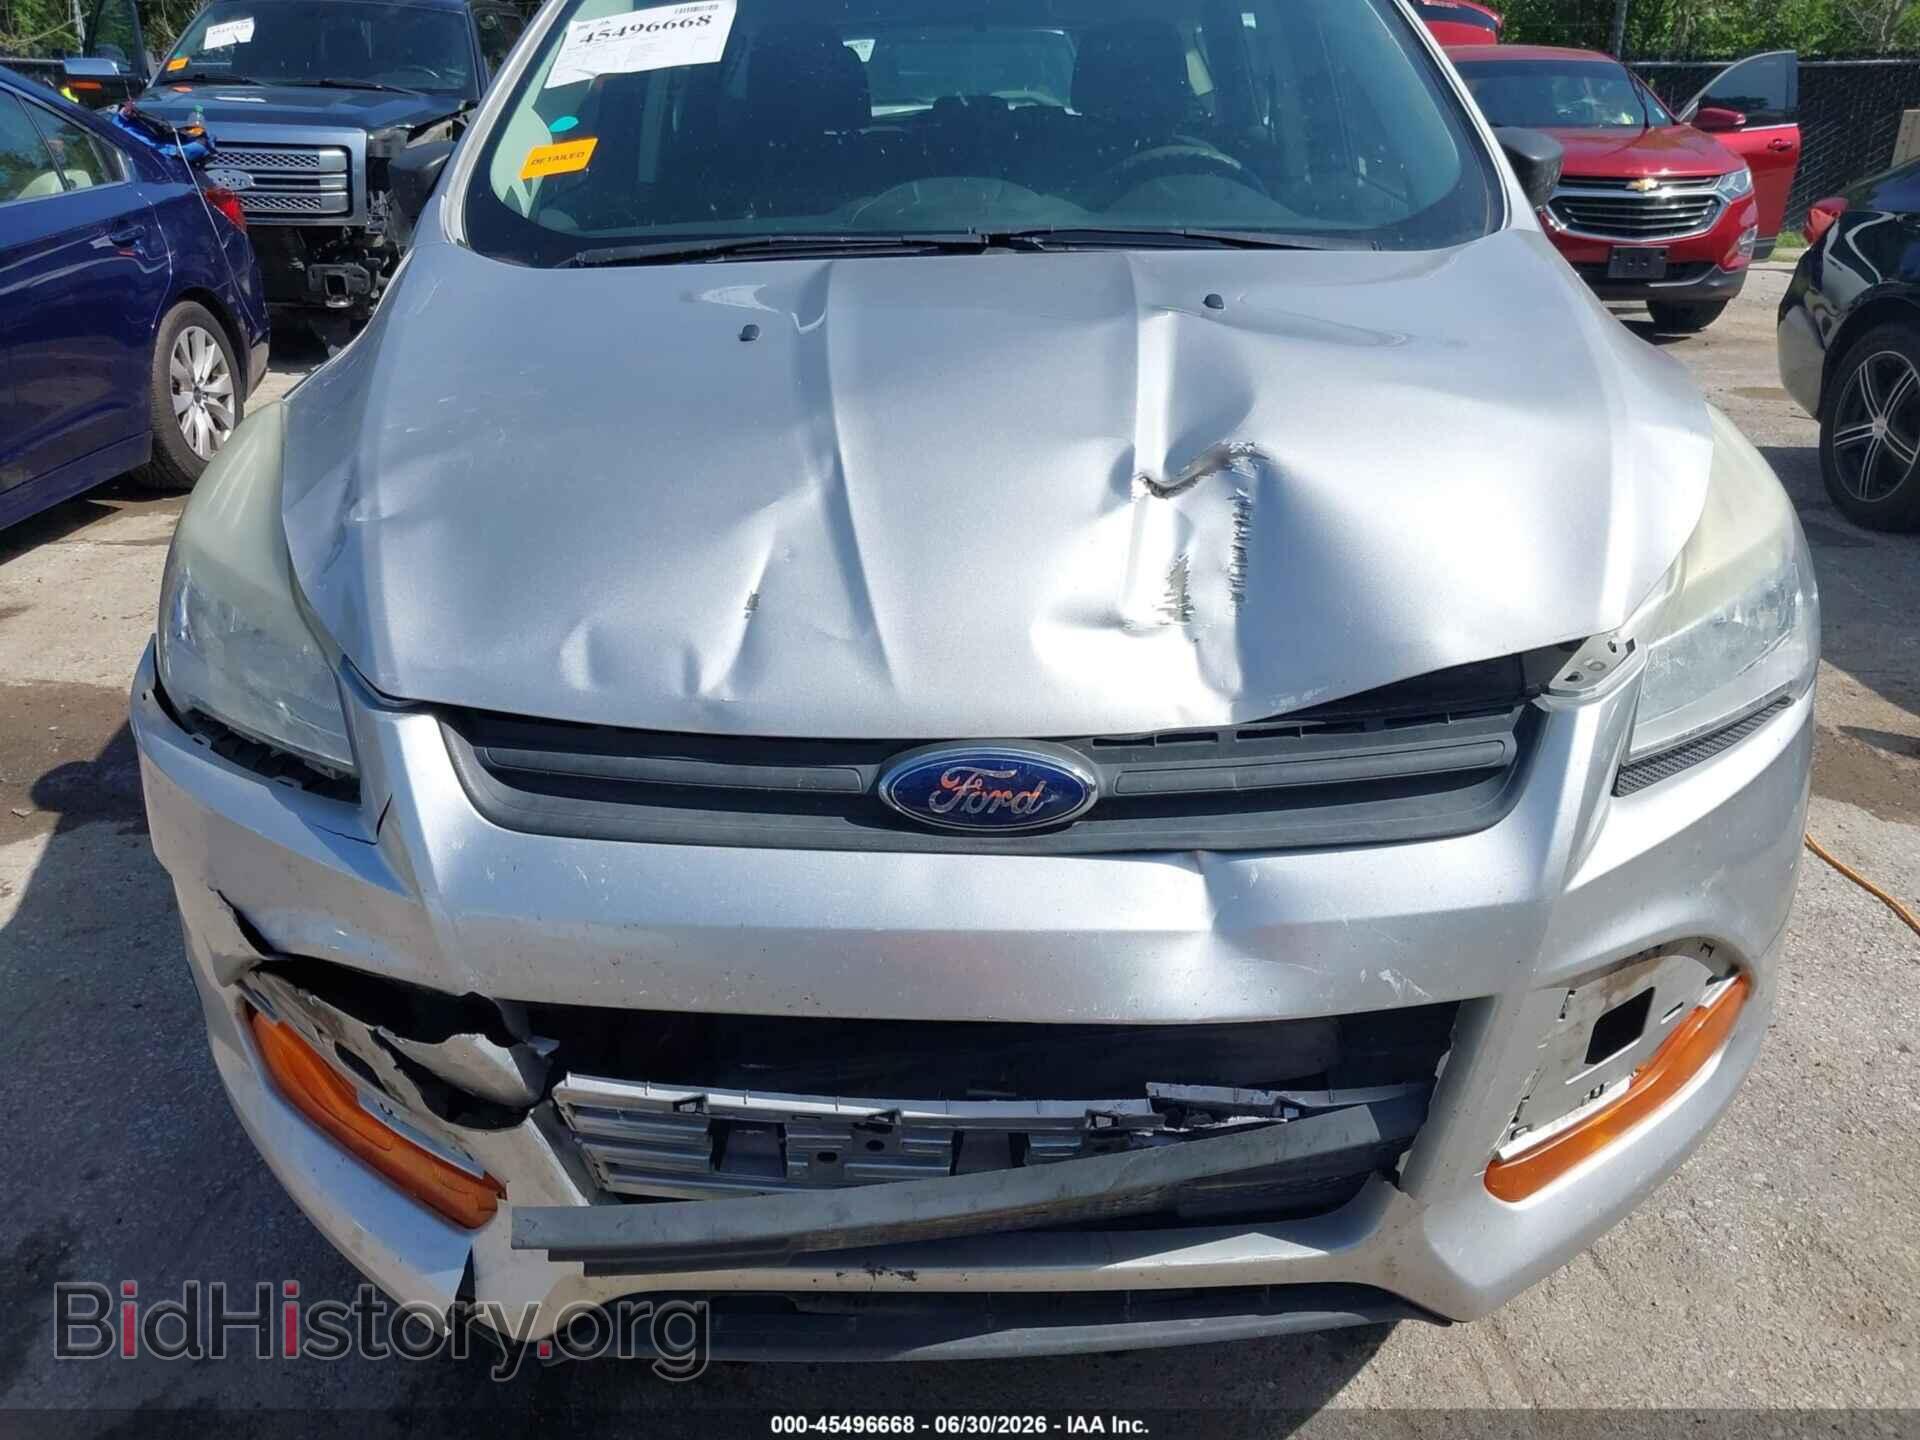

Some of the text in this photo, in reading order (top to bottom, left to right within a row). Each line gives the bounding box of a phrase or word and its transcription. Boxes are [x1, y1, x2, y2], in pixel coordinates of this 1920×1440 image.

[579, 14, 713, 44] 45496668
[531, 151, 585, 166] DETAILED
[929, 766, 1048, 814] Ford
